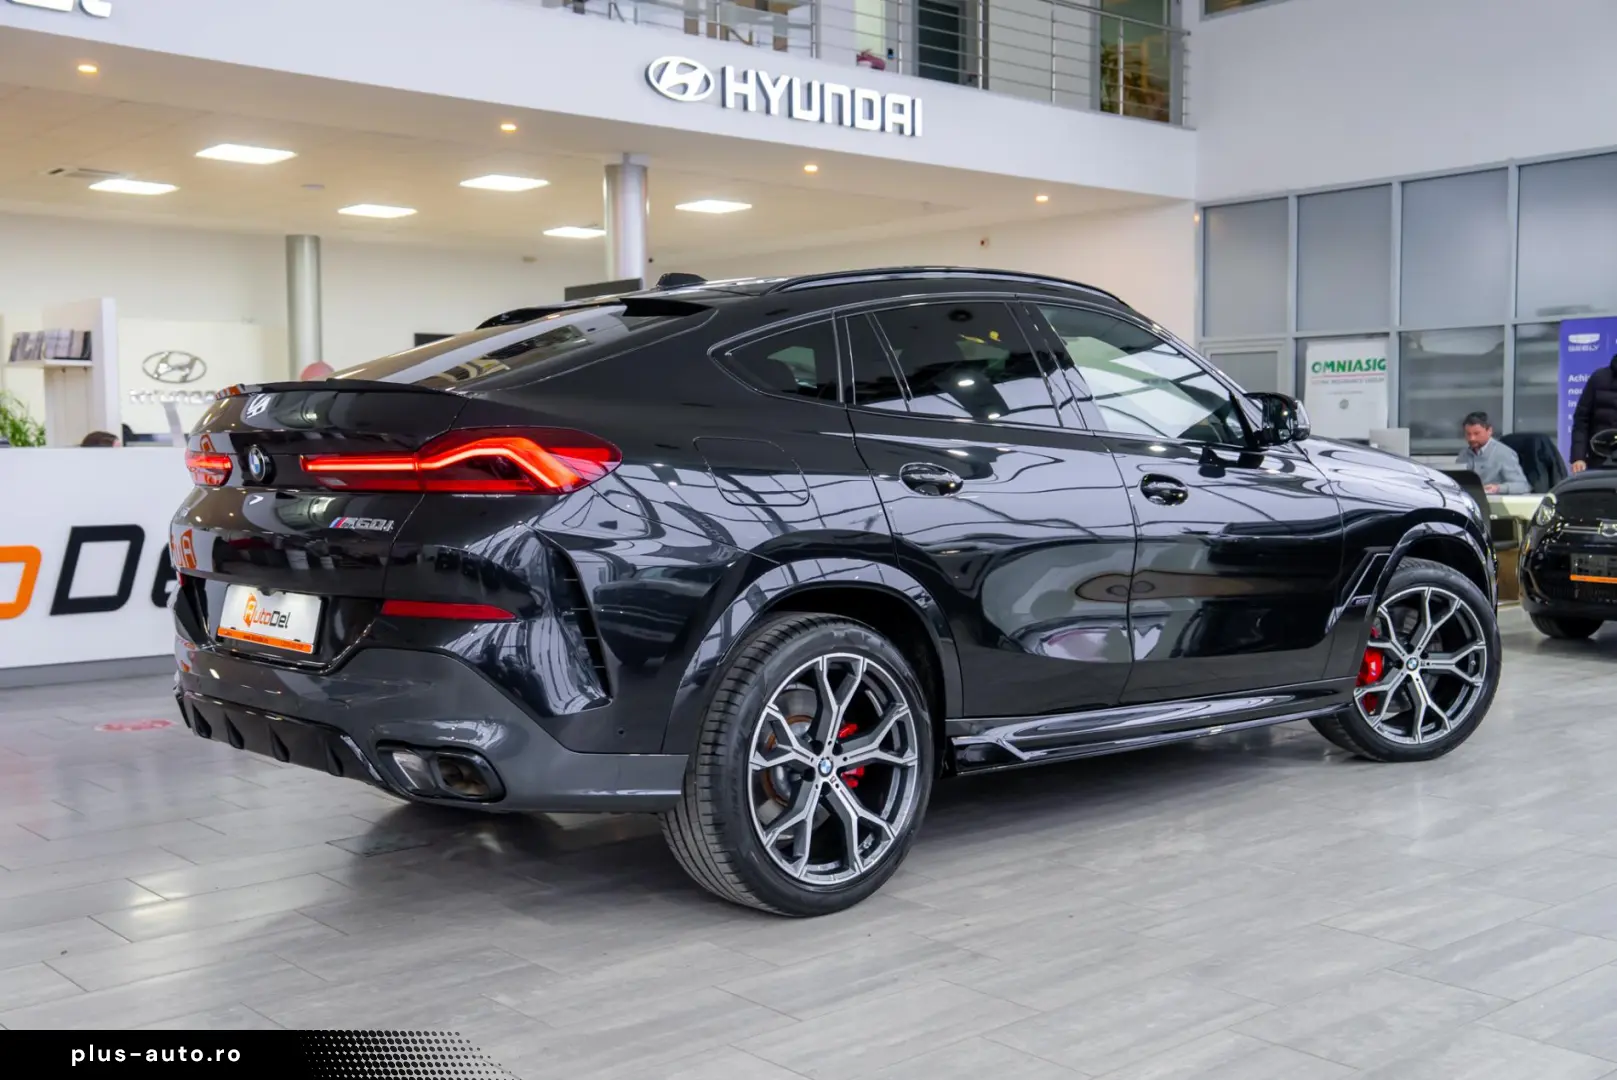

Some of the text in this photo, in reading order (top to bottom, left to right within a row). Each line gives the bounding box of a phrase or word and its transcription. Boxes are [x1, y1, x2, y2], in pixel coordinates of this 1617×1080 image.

[721, 64, 922, 137] HYUNDAI
[1311, 357, 1387, 374] OMNIASIG
[243, 592, 291, 629] AutoDel
